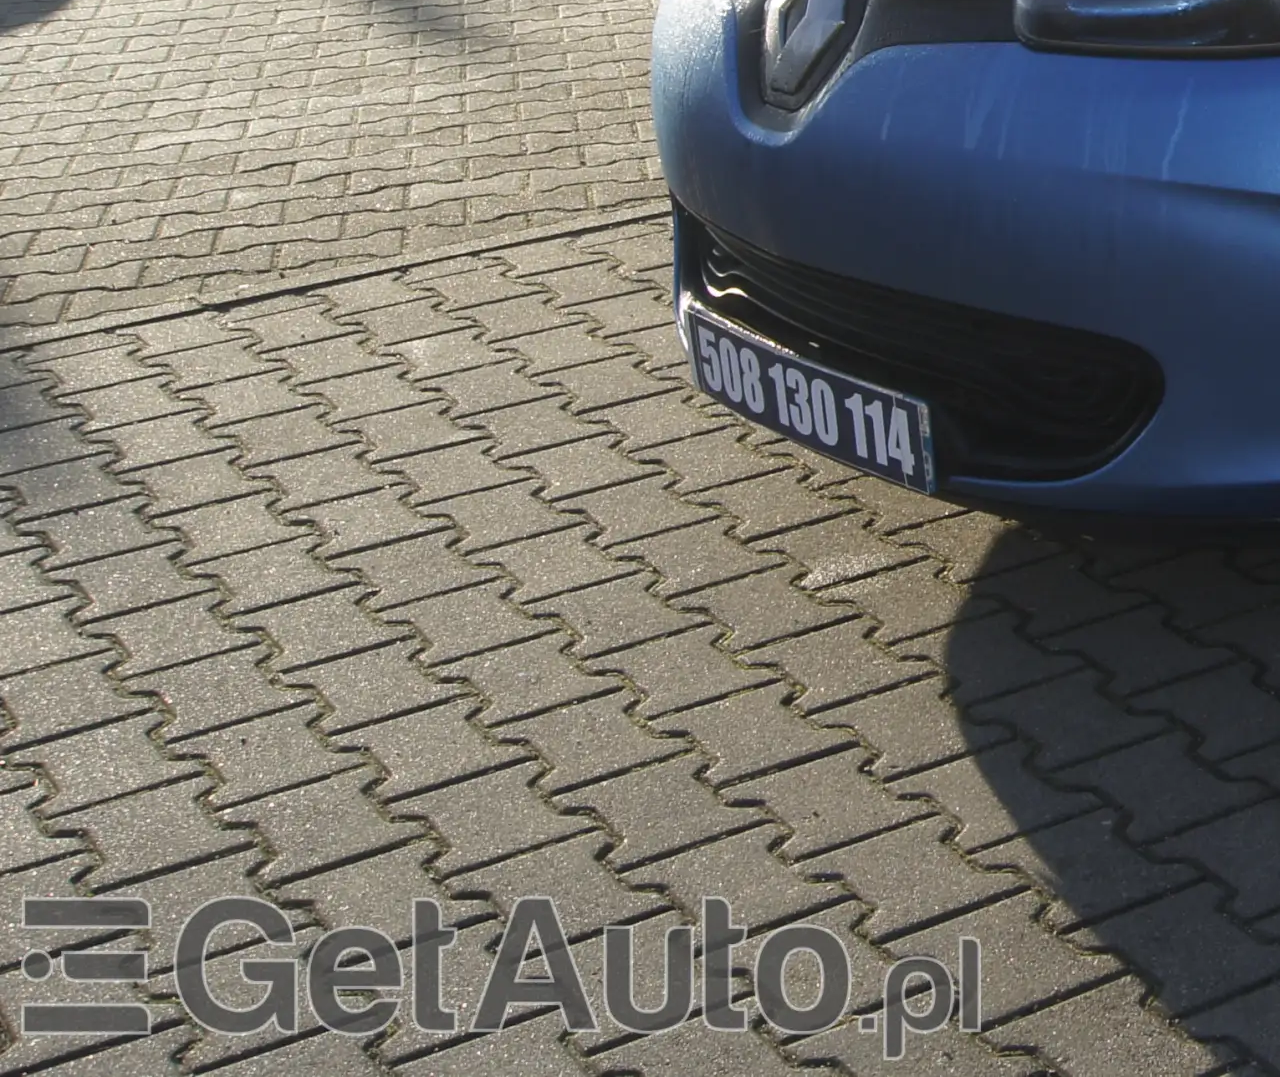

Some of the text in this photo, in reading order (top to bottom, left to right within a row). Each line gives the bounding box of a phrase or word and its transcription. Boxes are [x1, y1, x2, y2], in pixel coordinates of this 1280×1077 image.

[697, 325, 915, 476] 508 130 114
